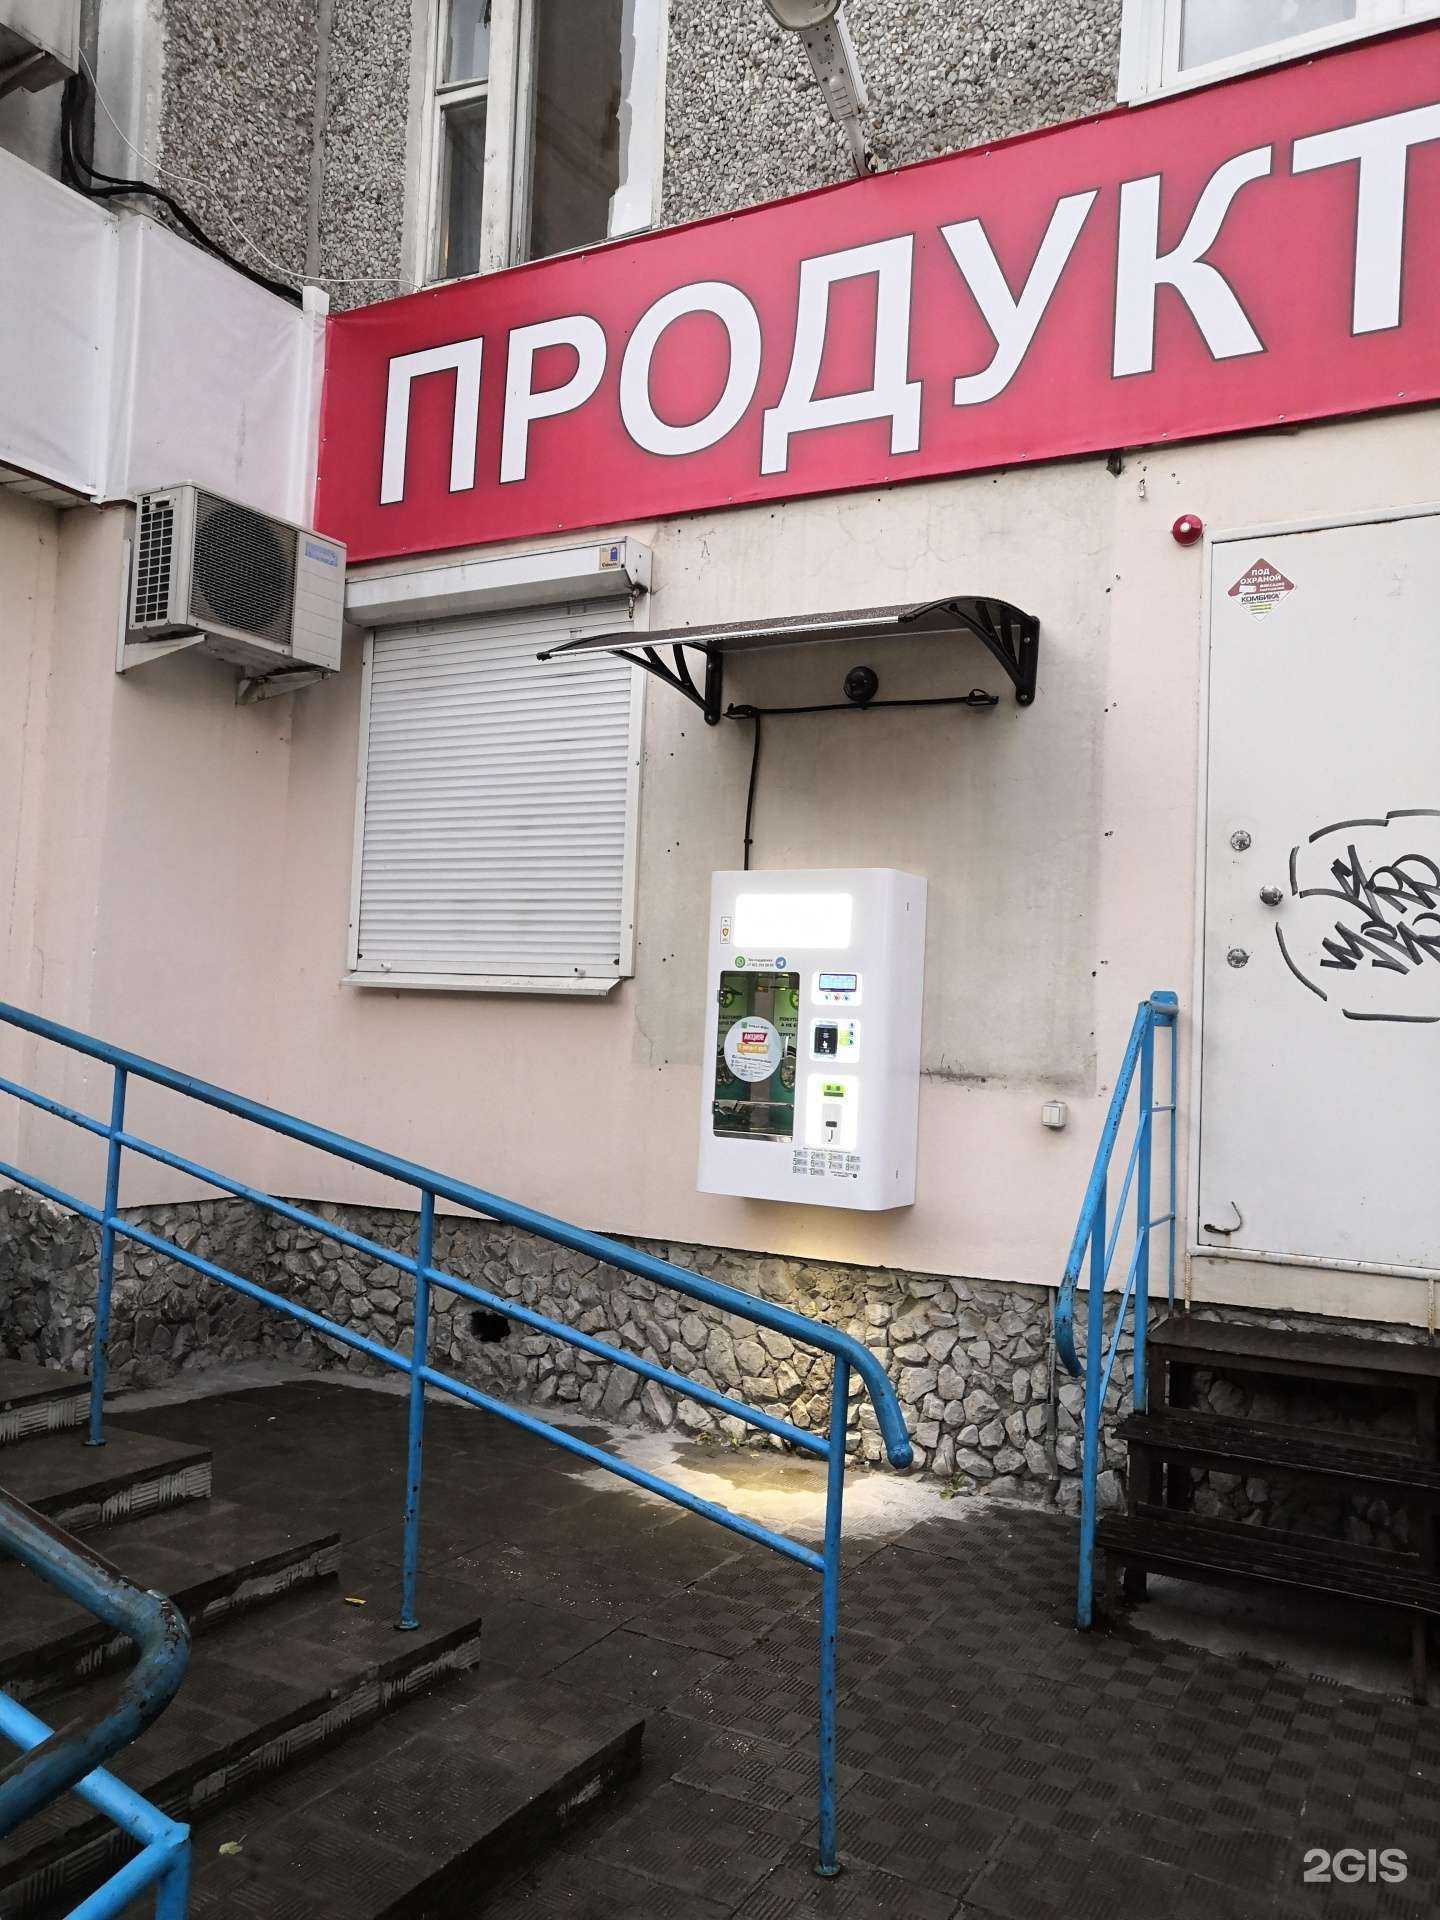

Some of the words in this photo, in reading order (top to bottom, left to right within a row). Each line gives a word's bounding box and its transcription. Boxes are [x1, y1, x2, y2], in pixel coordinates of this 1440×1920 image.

[378, 102, 1440, 506] ПРОДУКТ
[1251, 568, 1270, 576] ПОД
[1240, 575, 1281, 584] ОХРАНОЙ
